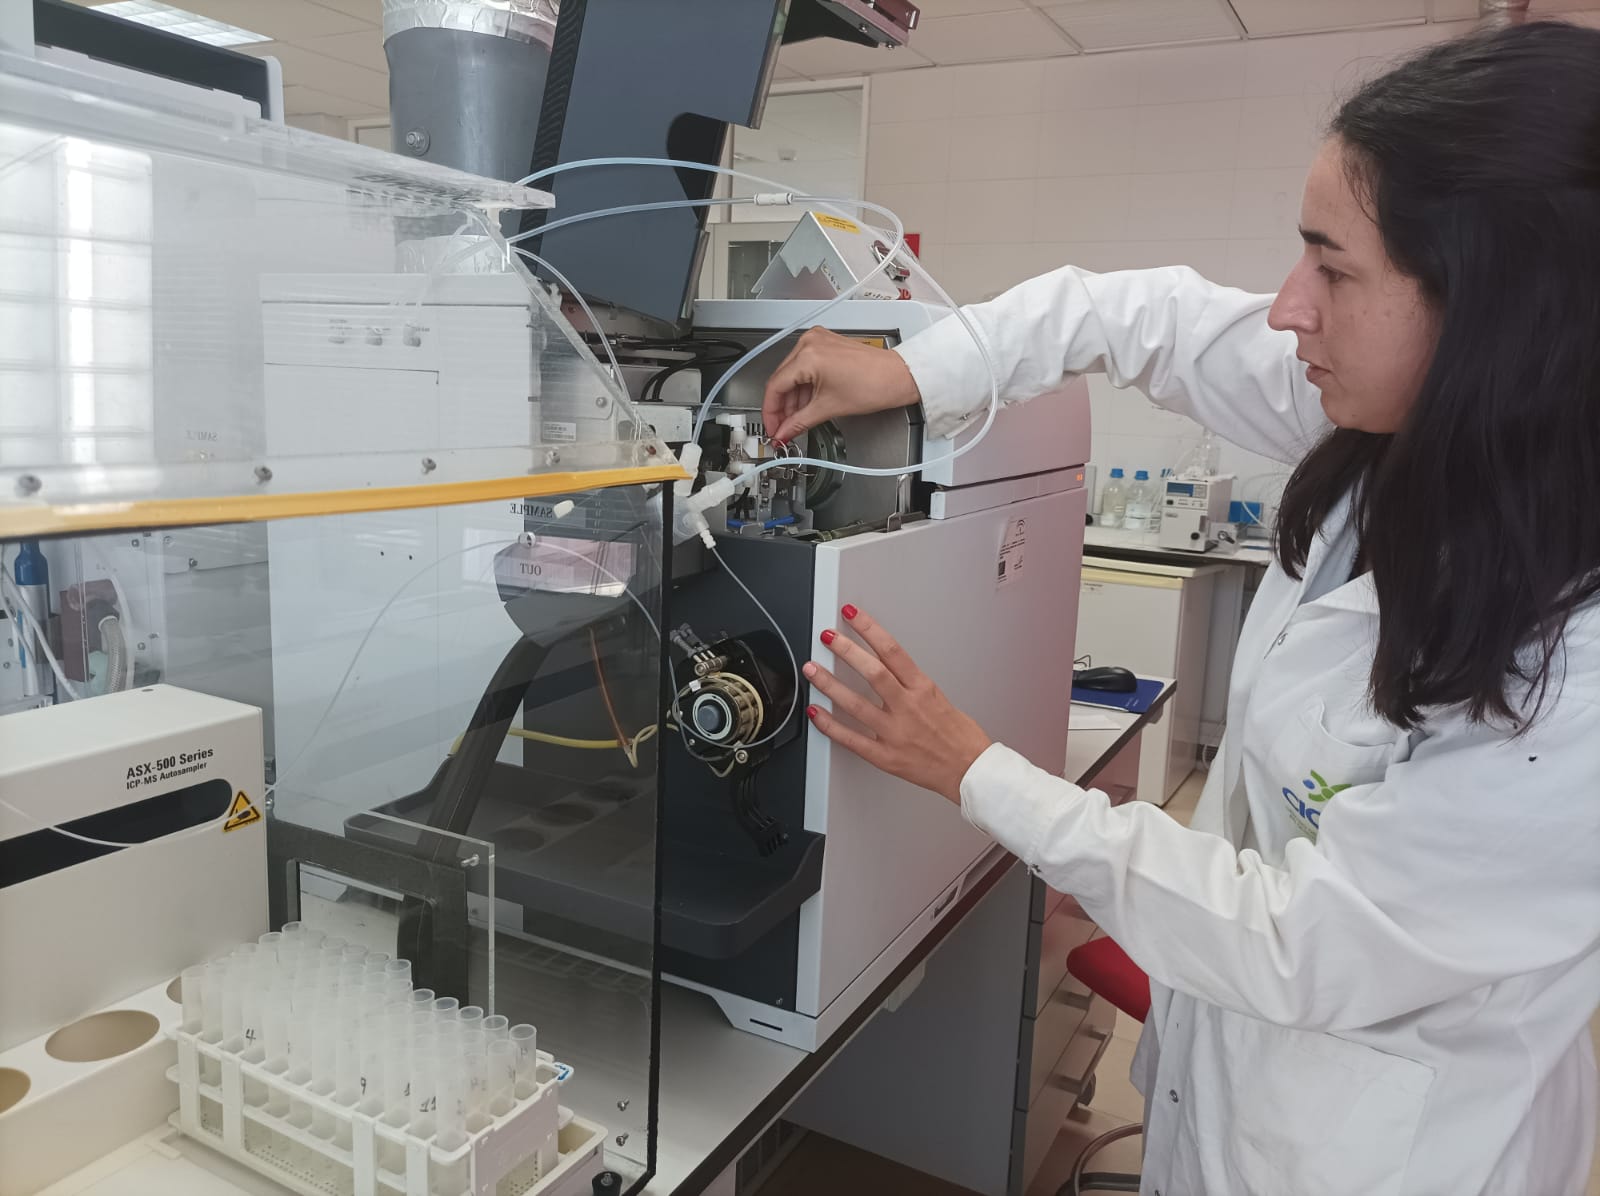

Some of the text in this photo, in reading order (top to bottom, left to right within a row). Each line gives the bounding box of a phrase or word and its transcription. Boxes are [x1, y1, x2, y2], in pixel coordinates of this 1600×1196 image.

[126, 748, 214, 779] ASX-500 Series
[126, 761, 207, 790] ICP-MS Autosampler
